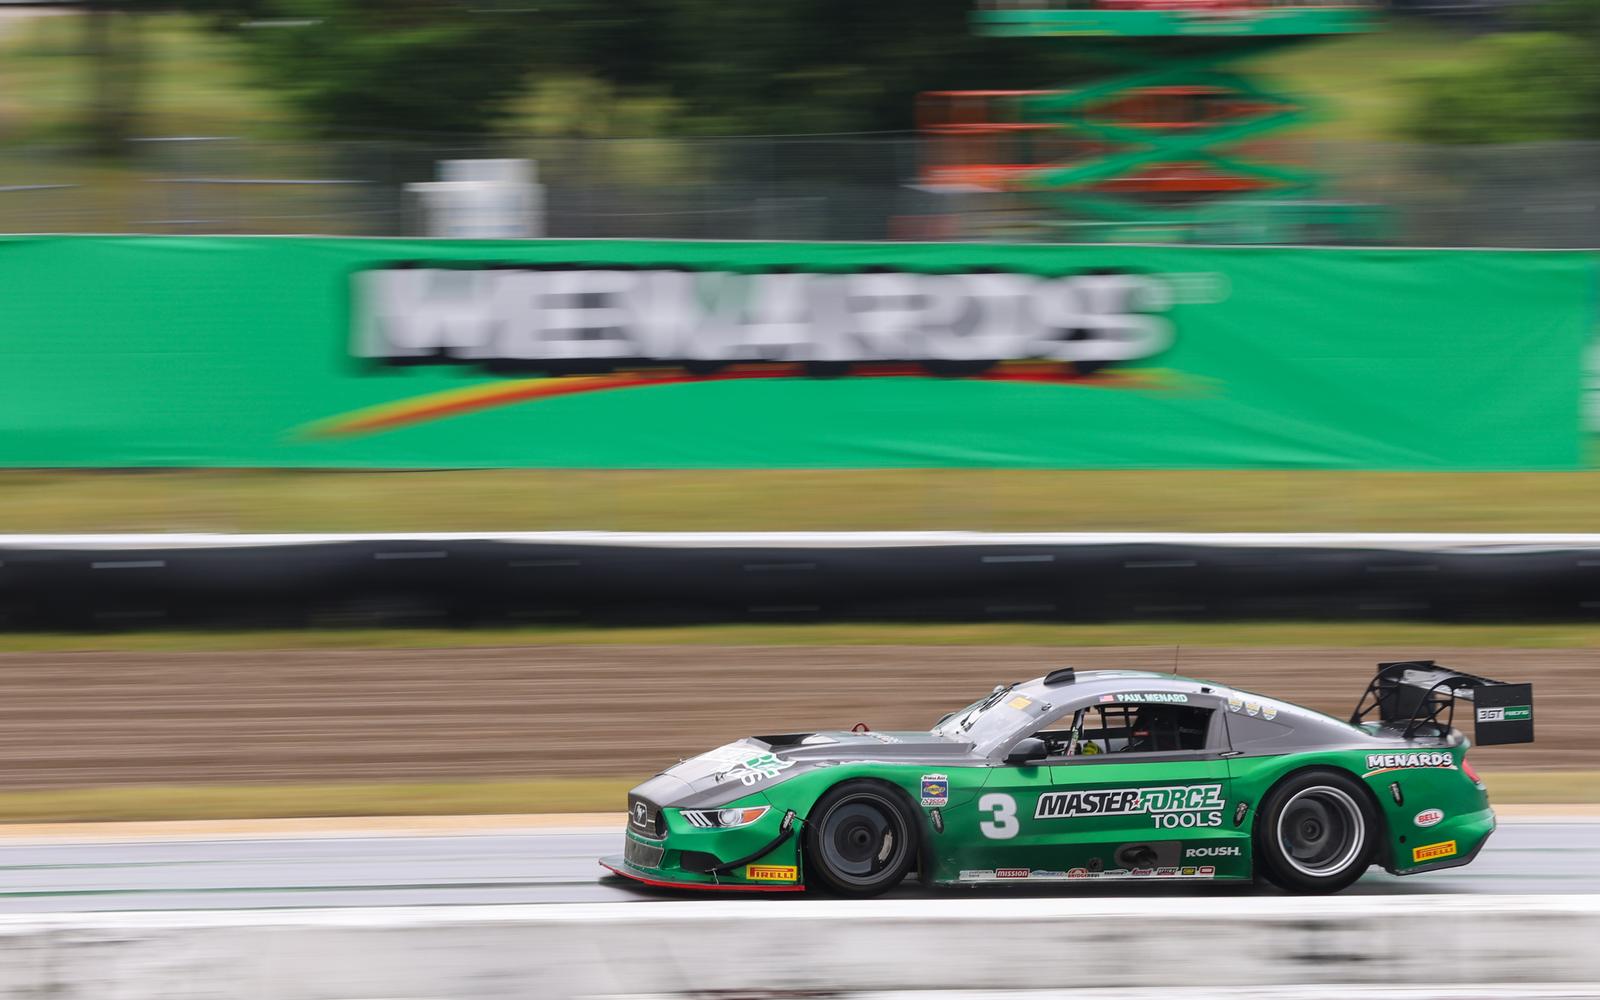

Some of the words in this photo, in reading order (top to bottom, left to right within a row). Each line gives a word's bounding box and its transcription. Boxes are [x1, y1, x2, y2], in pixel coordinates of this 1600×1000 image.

[1116, 693, 1146, 703] PAUL
[1146, 693, 1189, 704] MENARD
[1367, 752, 1453, 769] MENARDS
[978, 793, 1020, 840] 3
[1151, 811, 1223, 829] TOOLS
[1418, 812, 1440, 824] BELL
[1415, 843, 1454, 859] PIRELLI
[749, 867, 795, 879] PIRELLI
